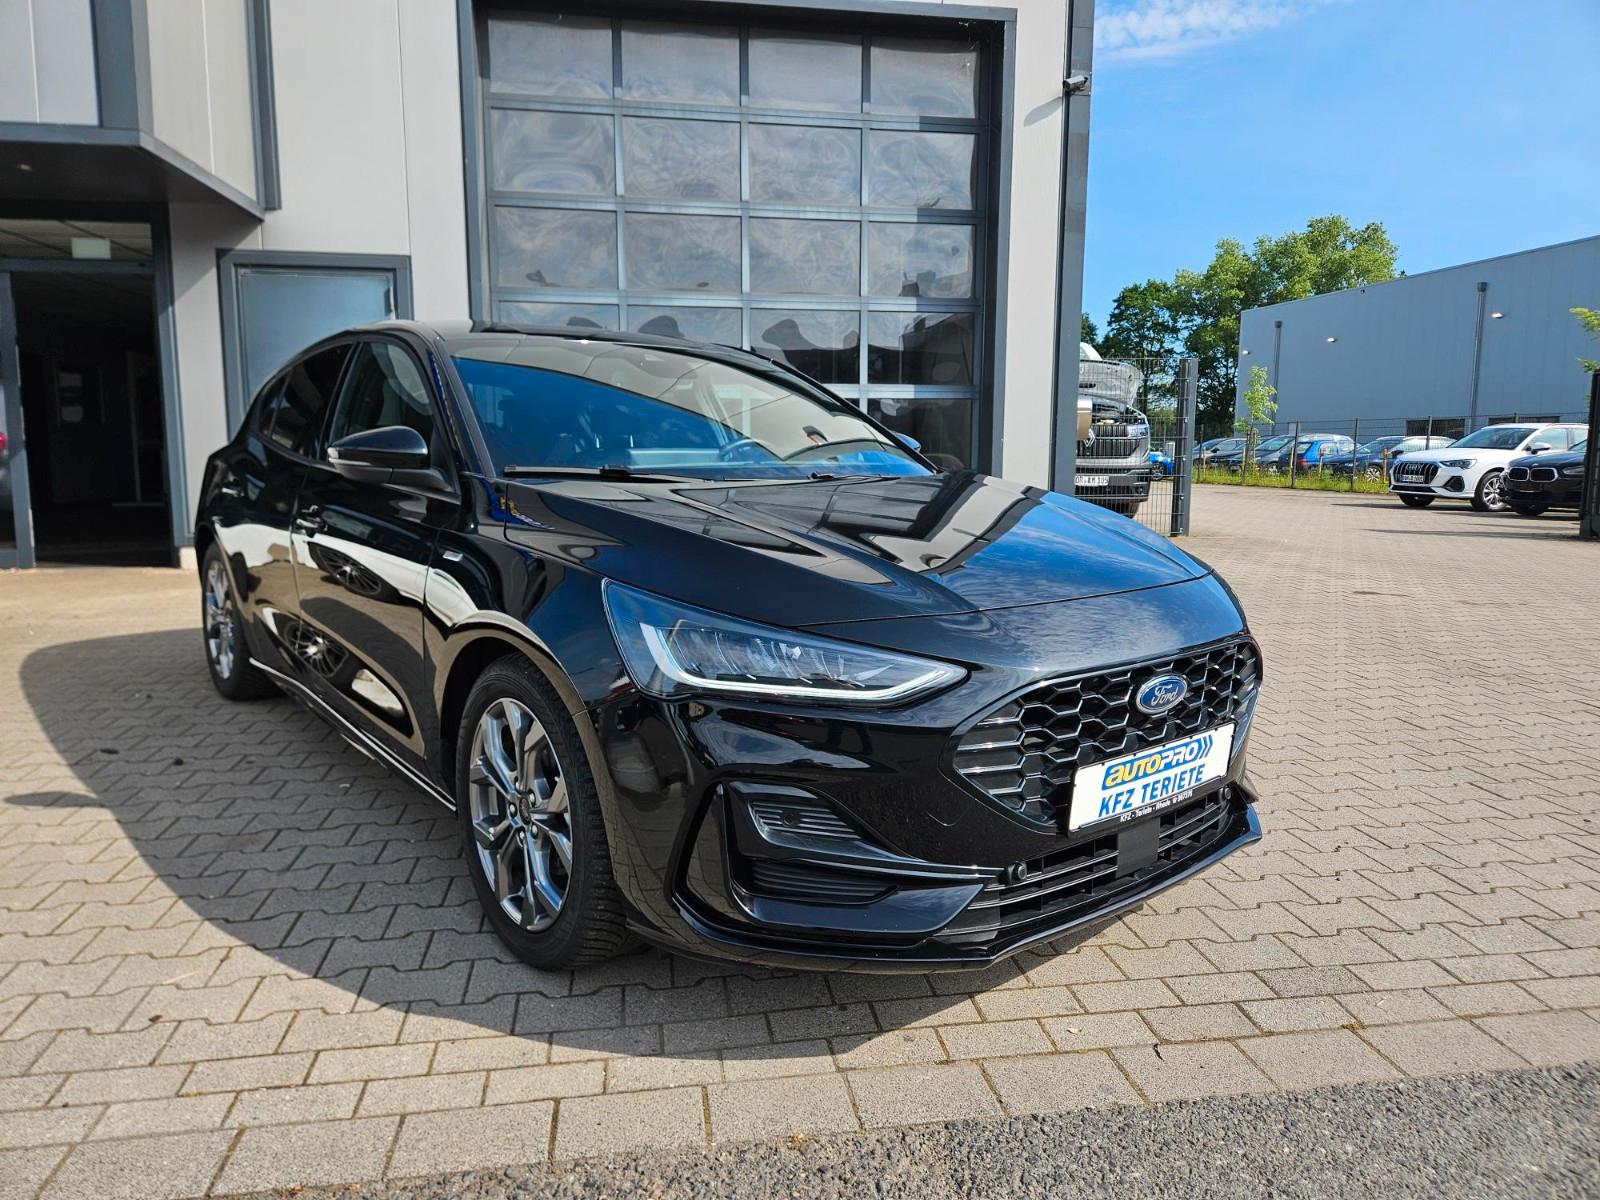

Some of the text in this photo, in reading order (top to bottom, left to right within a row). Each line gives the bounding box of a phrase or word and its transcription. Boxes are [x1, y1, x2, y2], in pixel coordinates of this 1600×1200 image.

[1151, 684, 1179, 706] Ford
[1098, 788, 1136, 817] KFZ
[1141, 763, 1206, 803] TERIETE
